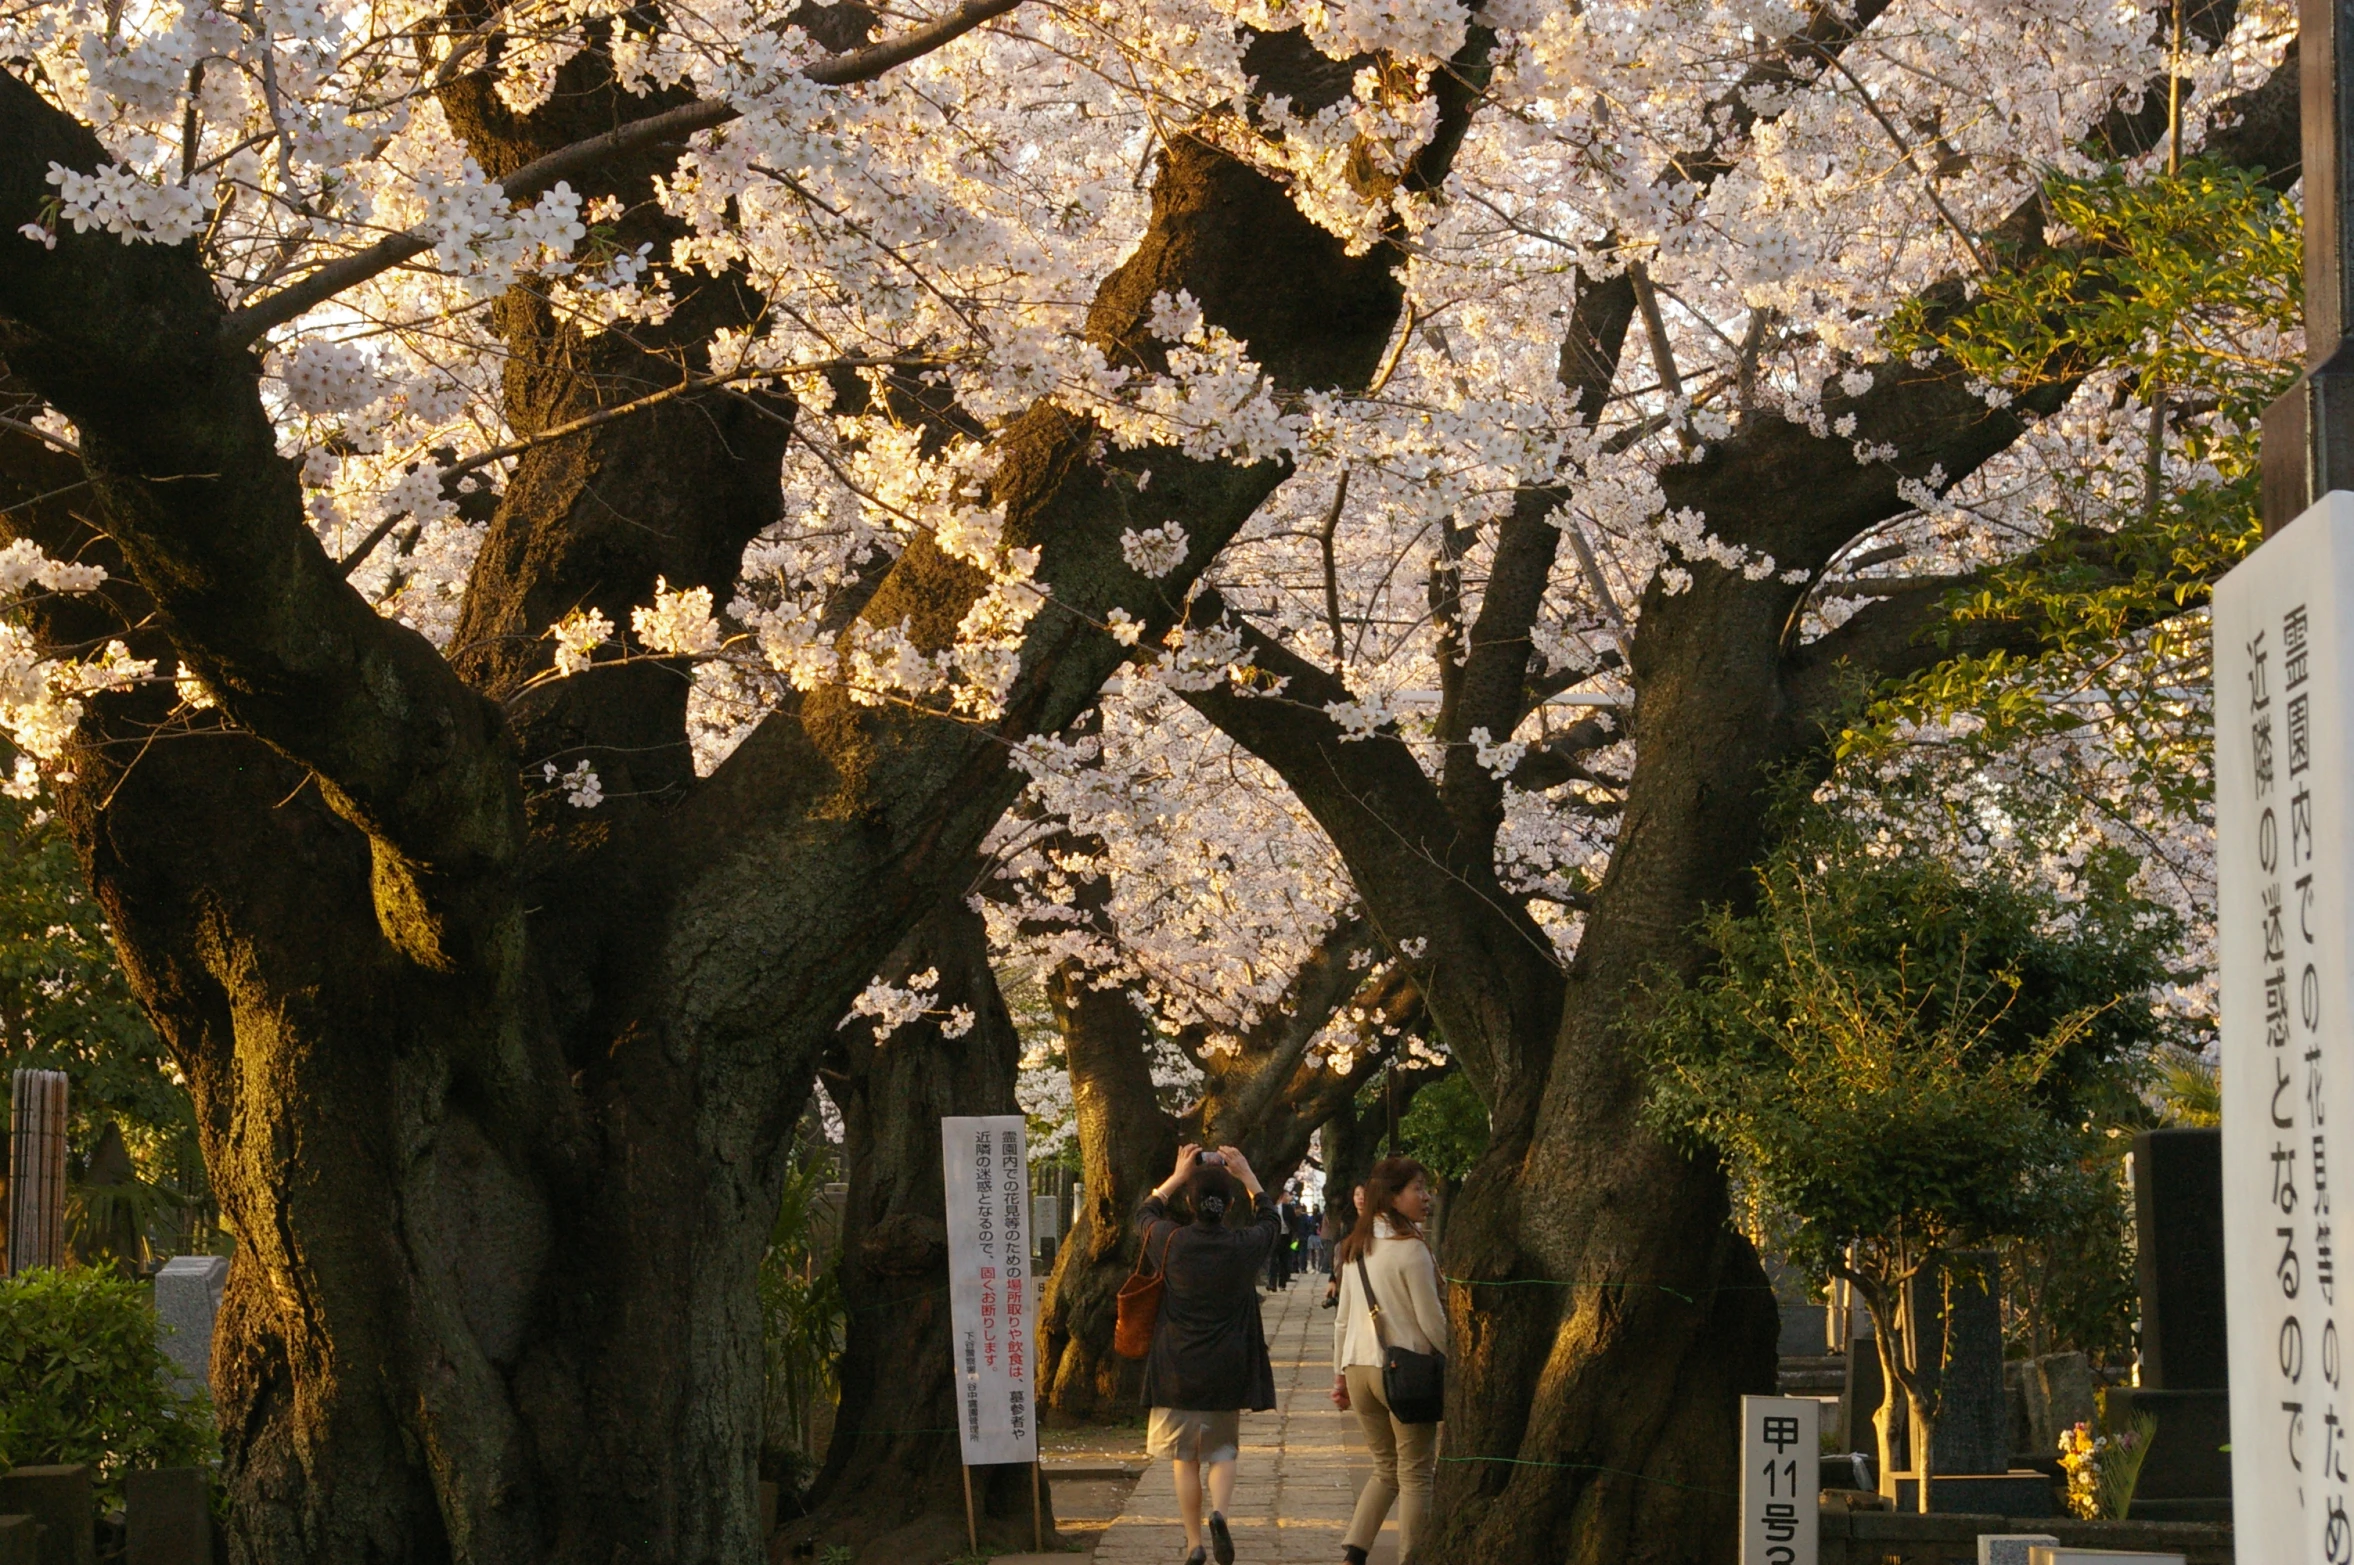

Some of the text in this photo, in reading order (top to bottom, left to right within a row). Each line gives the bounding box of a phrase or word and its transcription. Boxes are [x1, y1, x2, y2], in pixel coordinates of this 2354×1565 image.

[2246, 628, 2304, 1509] 近隣の迷惑となるので、
